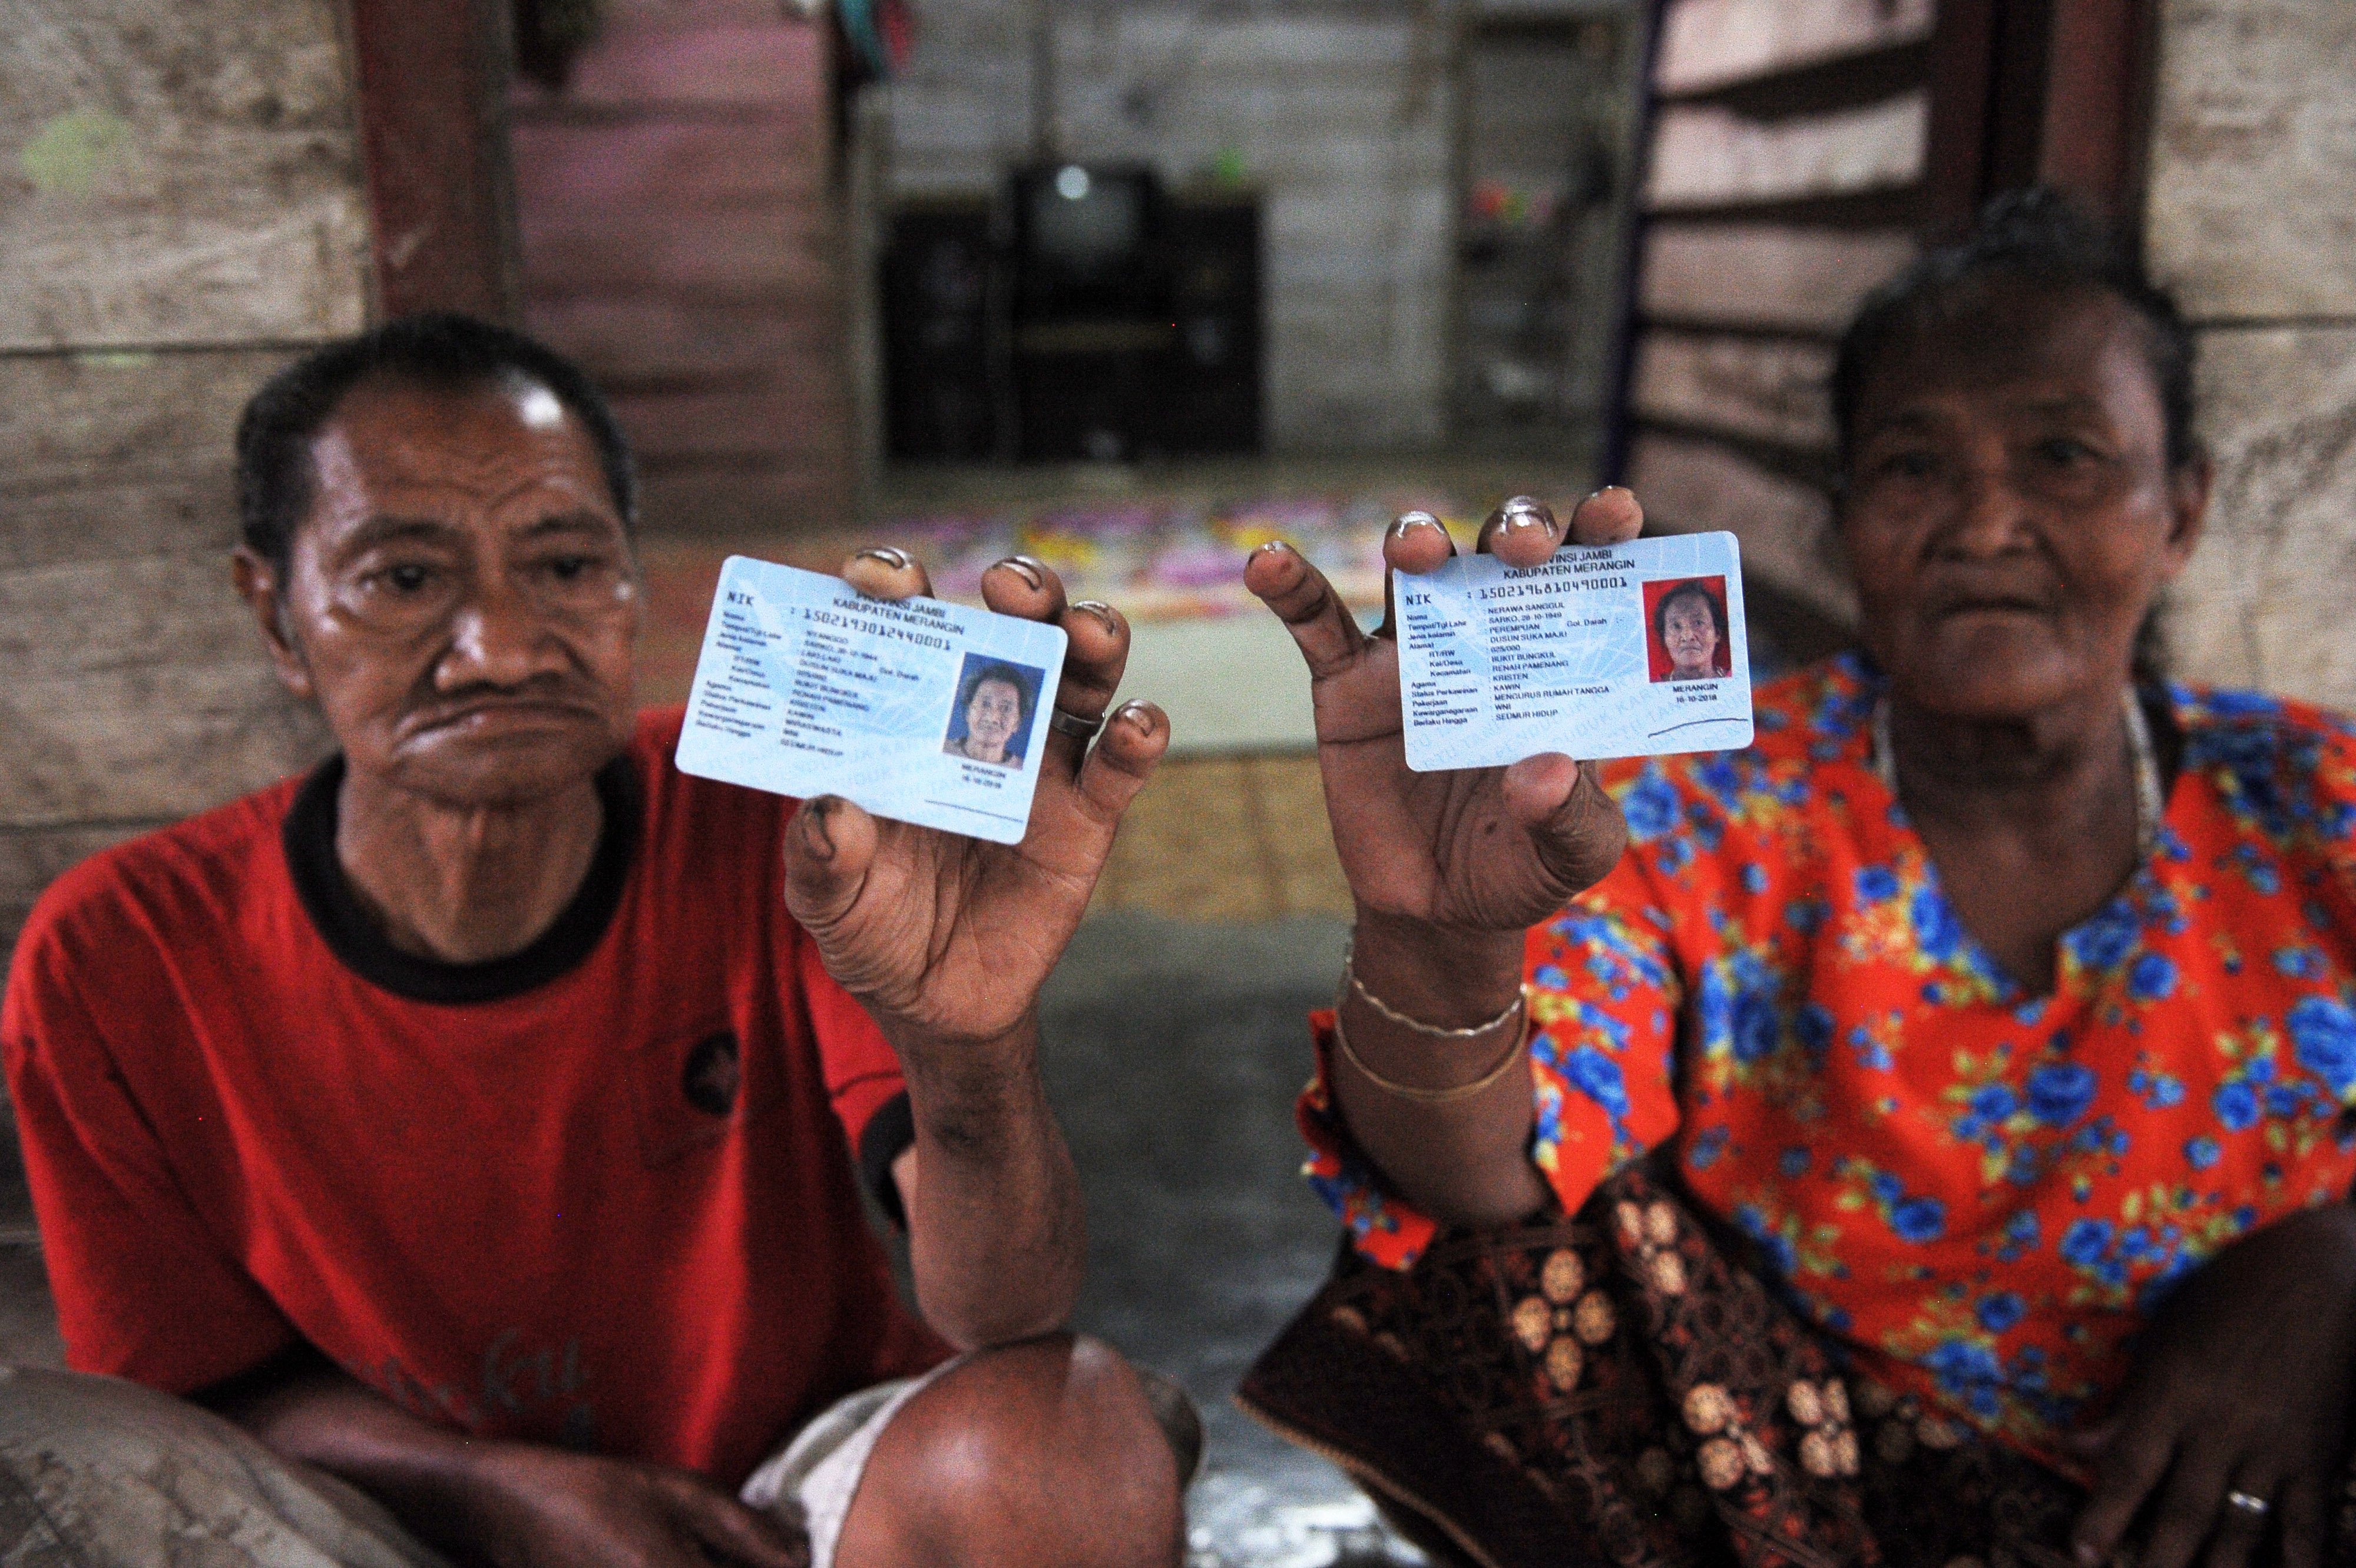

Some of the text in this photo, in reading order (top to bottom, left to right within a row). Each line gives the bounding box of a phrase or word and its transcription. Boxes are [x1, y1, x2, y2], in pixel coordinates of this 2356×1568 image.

[1581, 549, 1612, 561] JAMBI
[1503, 558, 1635, 579] KABUPATEN MERANGIN
[1405, 593, 1431, 606] NIK
[1479, 576, 1627, 599] 1502196810490001
[832, 597, 965, 635] KABUPATEN MERANGIN
[911, 603, 946, 618] JAMBI
[1407, 601, 1564, 621] Nama NERAWA SANGGUL
[727, 591, 754, 606] NIK
[803, 608, 952, 650] 1502193012440001
[1489, 623, 1540, 634] PEREMPUAN
[1584, 617, 1607, 626] Darah
[1409, 641, 1434, 650] Alamat
[1490, 634, 1519, 643] DUSUN
[1517, 651, 1556, 660] BUNGKUL
[1430, 659, 1569, 677] Kecamatan RENAH PAMENANG
[1411, 673, 1528, 689] Agama KRISTEN
[1672, 683, 1718, 693] MERANGIN
[1411, 690, 1434, 698] Status
[1493, 683, 1520, 692] KAWIN
[1412, 685, 1609, 708] Pekerjaan MENGURUS RUMAH TANGGA
[1414, 709, 1558, 726] Berlaku Hingga SEUMUR HIDUP
